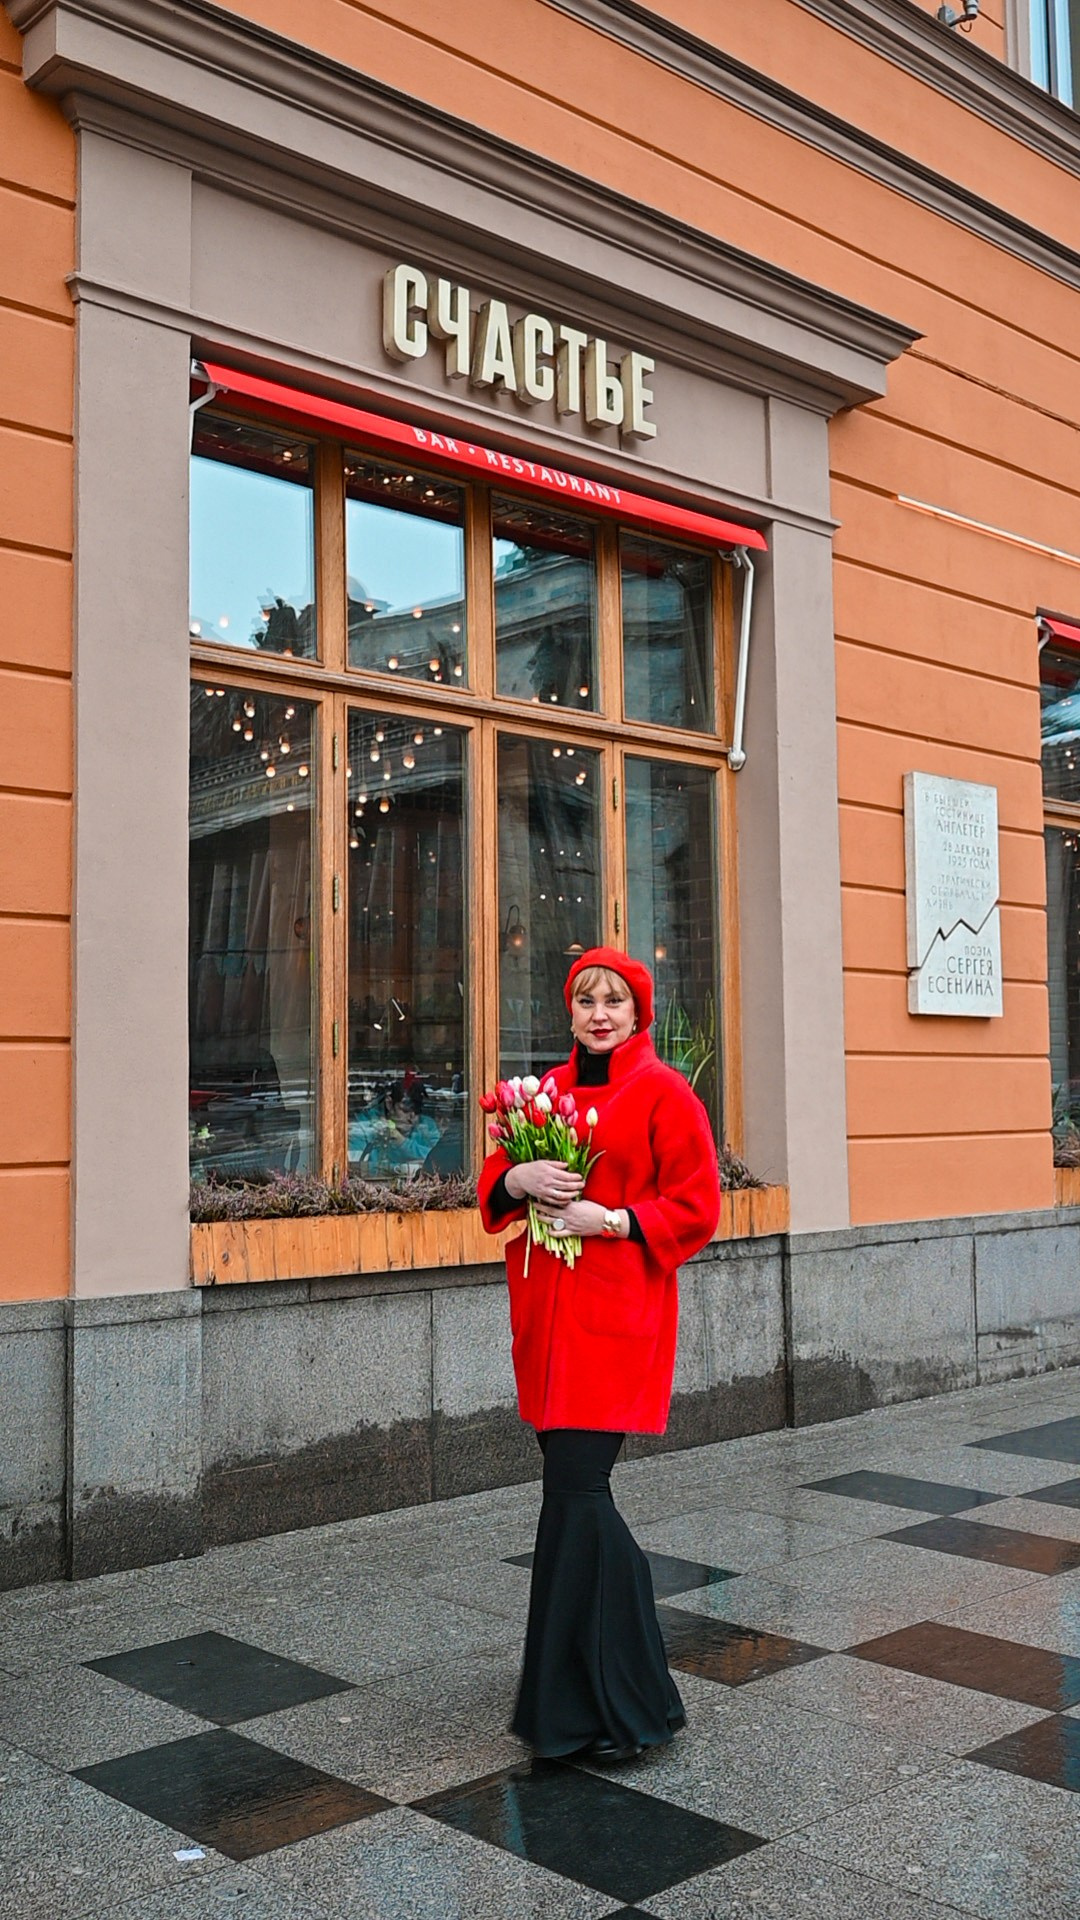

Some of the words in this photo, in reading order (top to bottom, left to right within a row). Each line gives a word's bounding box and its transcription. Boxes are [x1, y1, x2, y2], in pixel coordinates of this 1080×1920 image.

[383, 264, 657, 441] СЧАСТЬЕ
[412, 427, 459, 454] BAR
[484, 449, 621, 504] RESTAURANT
[936, 806, 985, 824] ГОСТИНИЦЕ
[937, 820, 985, 839] АНГЛЕТЕР
[954, 844, 990, 858] ДЕКАБРЯ
[948, 856, 967, 868] 1925
[969, 858, 990, 870] ГОДА
[964, 945, 992, 957] ПОЭТА
[947, 956, 993, 976] СЕРГЕЯ
[928, 976, 994, 996] ЕСЕНИНА
